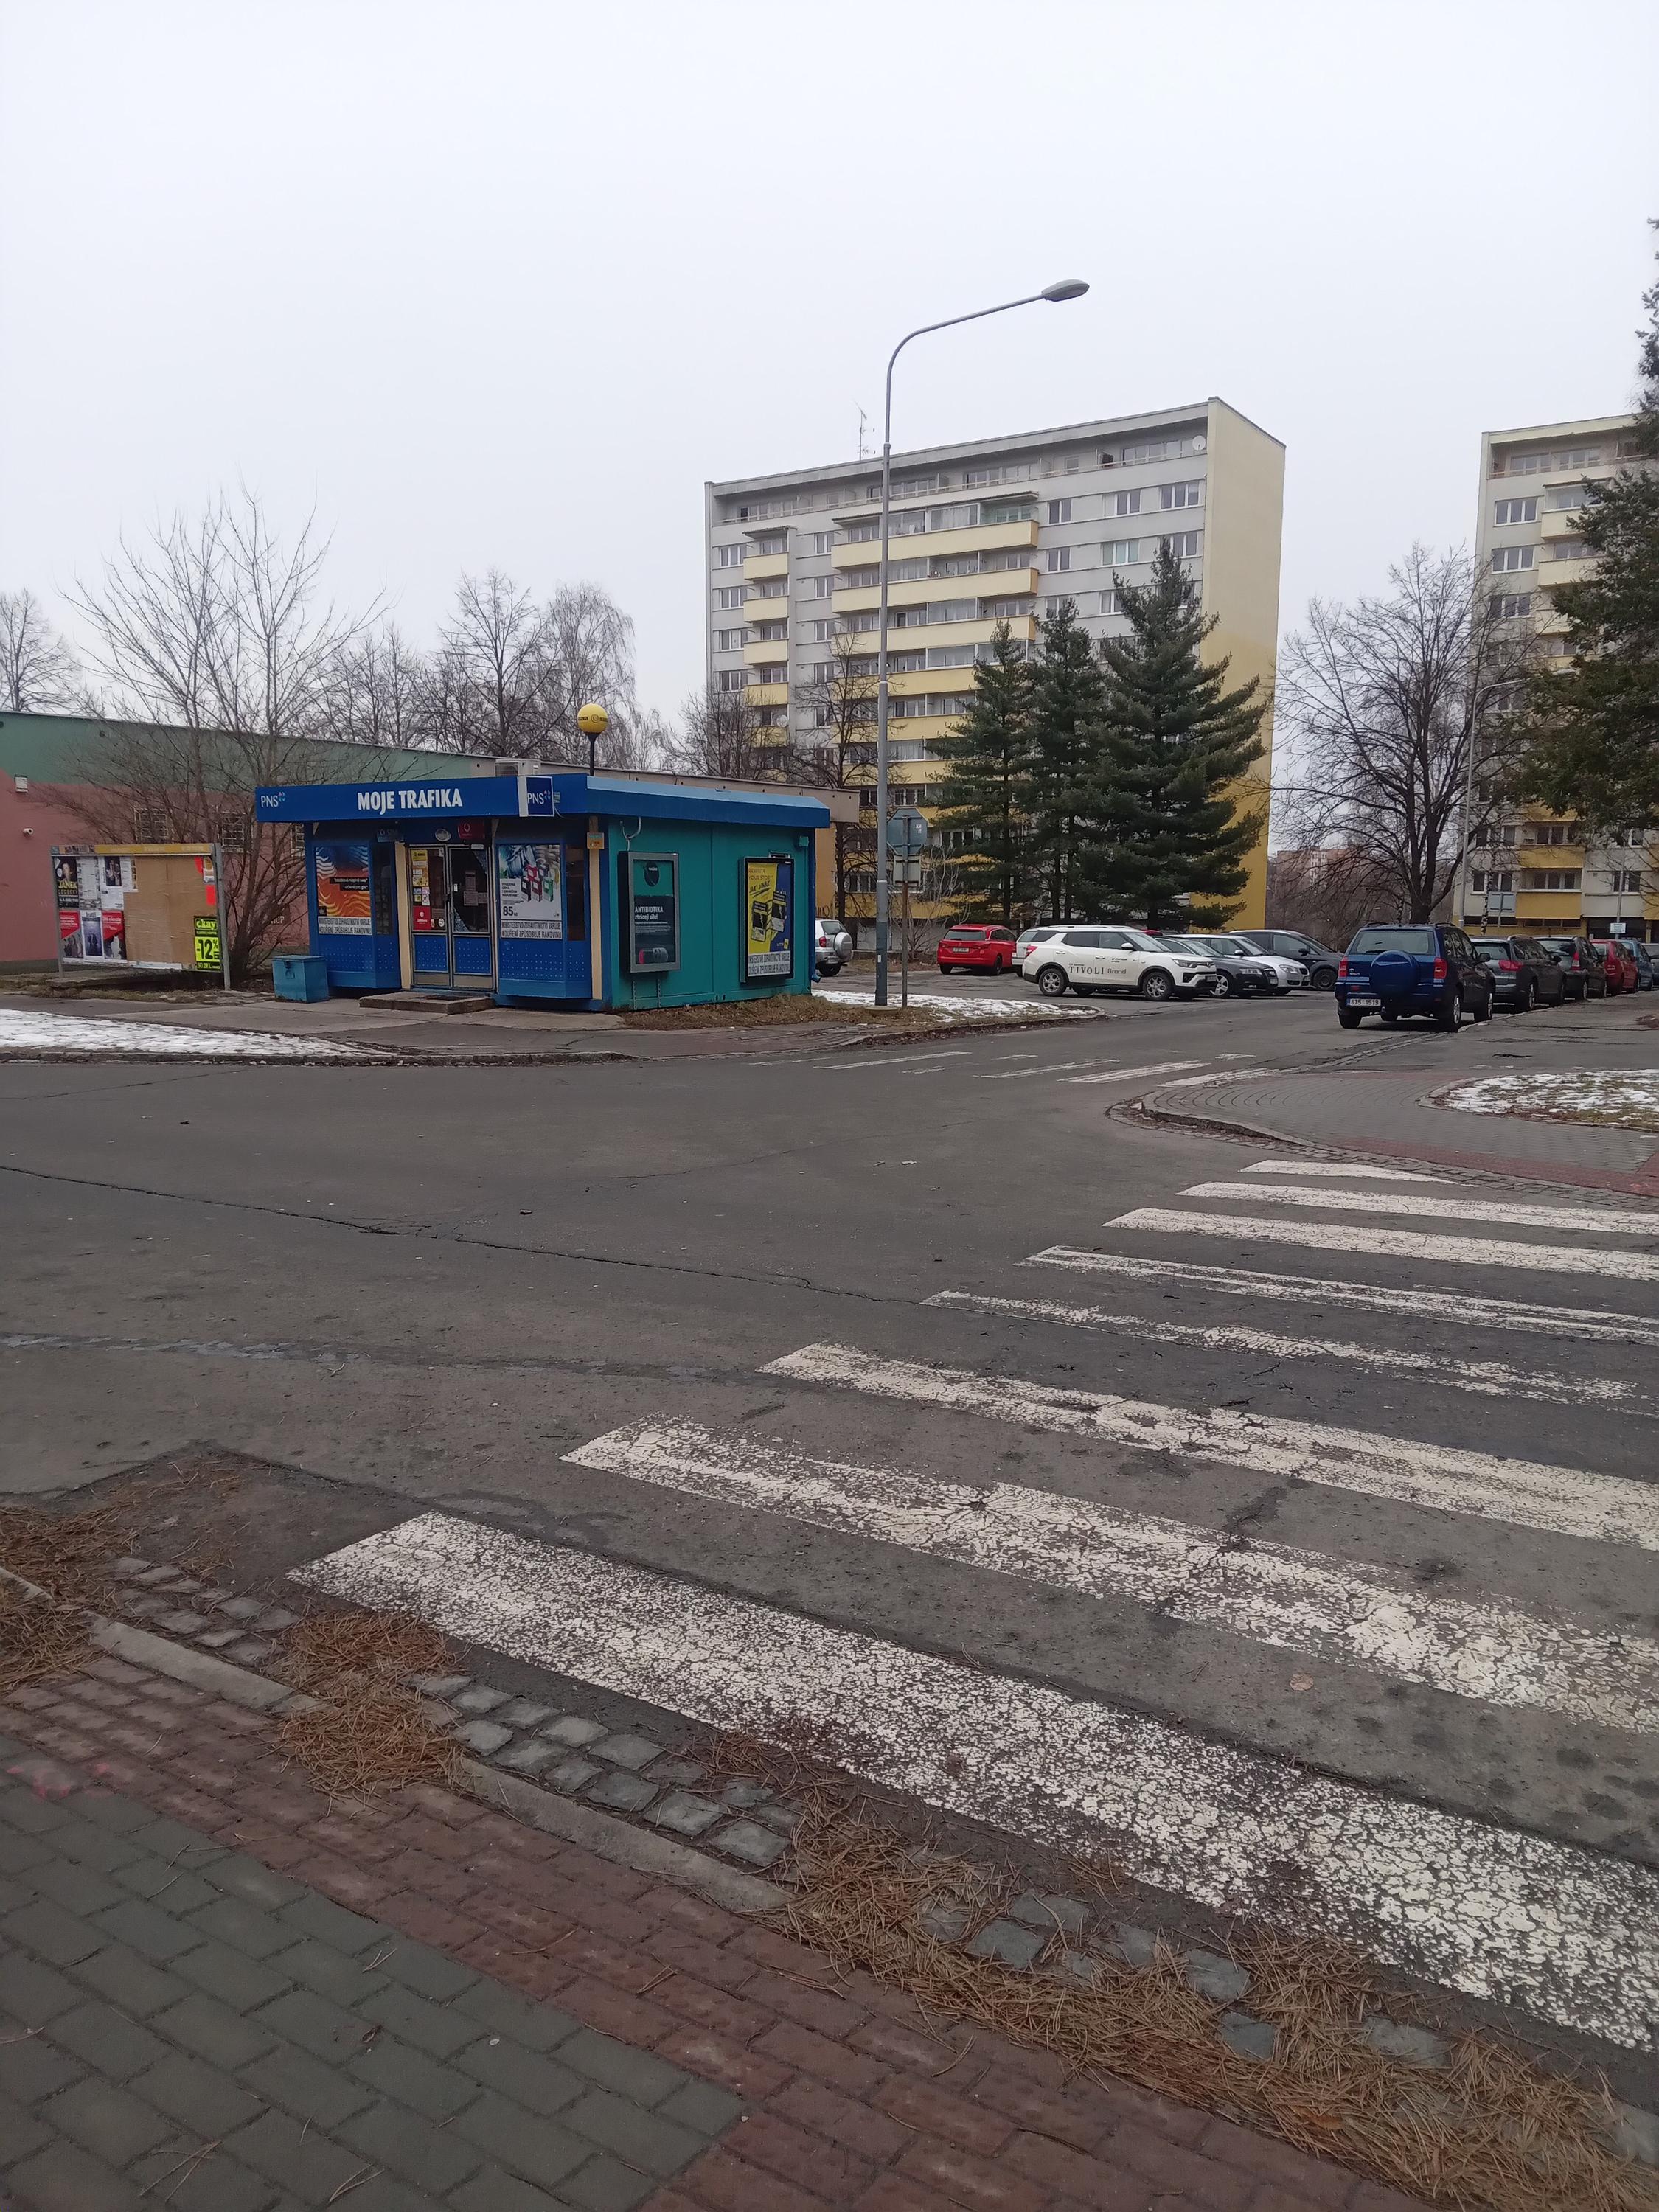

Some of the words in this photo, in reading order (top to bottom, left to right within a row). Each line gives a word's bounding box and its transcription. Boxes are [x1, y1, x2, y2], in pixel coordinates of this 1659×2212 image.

[261, 795, 279, 808] PNS
[358, 791, 394, 815] MOJE
[399, 788, 463, 809] TRAFIKA
[527, 793, 545, 804] PNS
[503, 906, 513, 916] 85
[1069, 967, 1105, 975] TIVOLI
